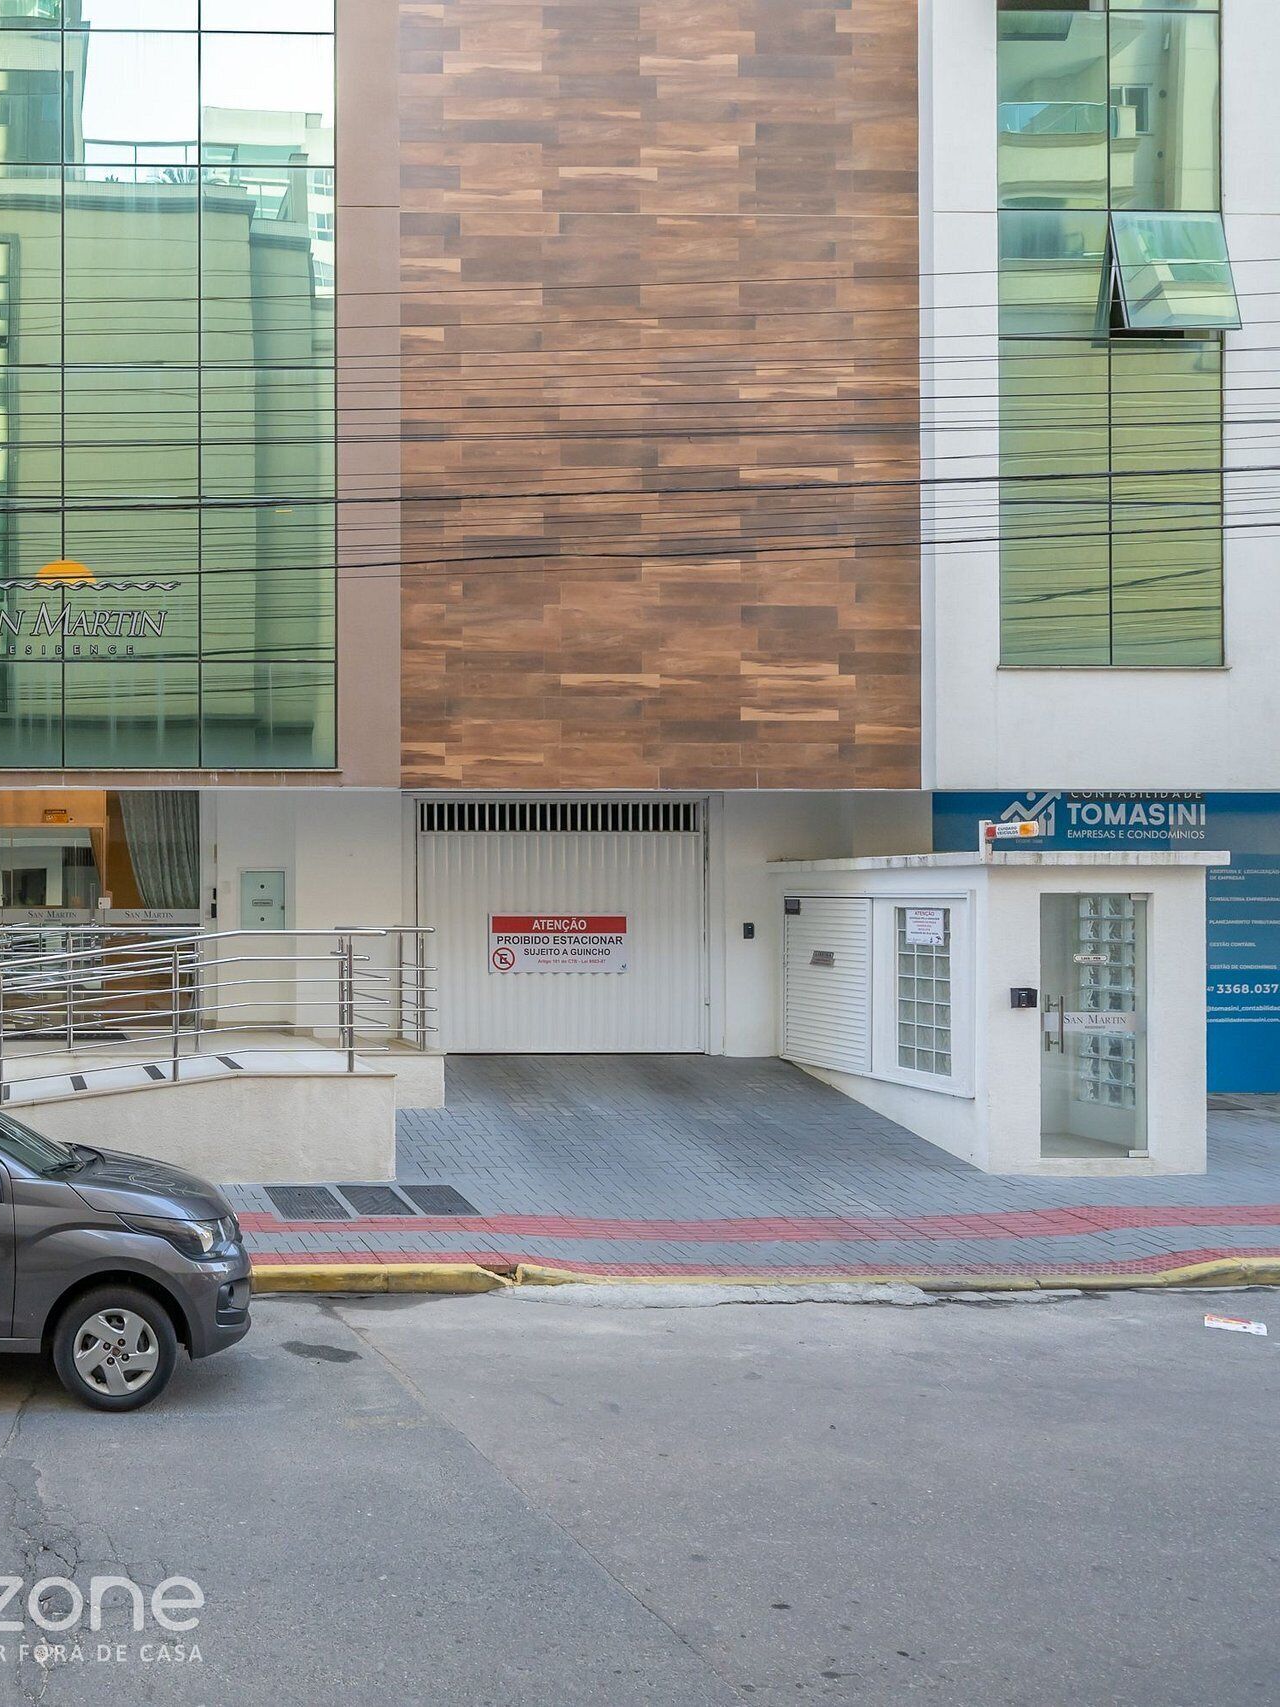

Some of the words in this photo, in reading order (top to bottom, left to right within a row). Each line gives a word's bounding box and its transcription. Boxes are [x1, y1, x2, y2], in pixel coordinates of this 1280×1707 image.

[30, 602, 168, 637] MARTIN
[1066, 803, 1206, 826] TOMASINI
[1067, 829, 1116, 839] EMPRESAS
[1119, 830, 1125, 839] E
[532, 918, 587, 932] ATENÇÃO
[497, 936, 550, 945] PROIBIDO
[553, 936, 623, 945] ESTACIONAR
[524, 948, 560, 956] SUJEITO
[570, 948, 611, 956] GUINCHO
[1216, 984, 1279, 994] 3368.037
[1064, 1014, 1083, 1024] SAN
[1088, 1014, 1127, 1024] MARTIN
